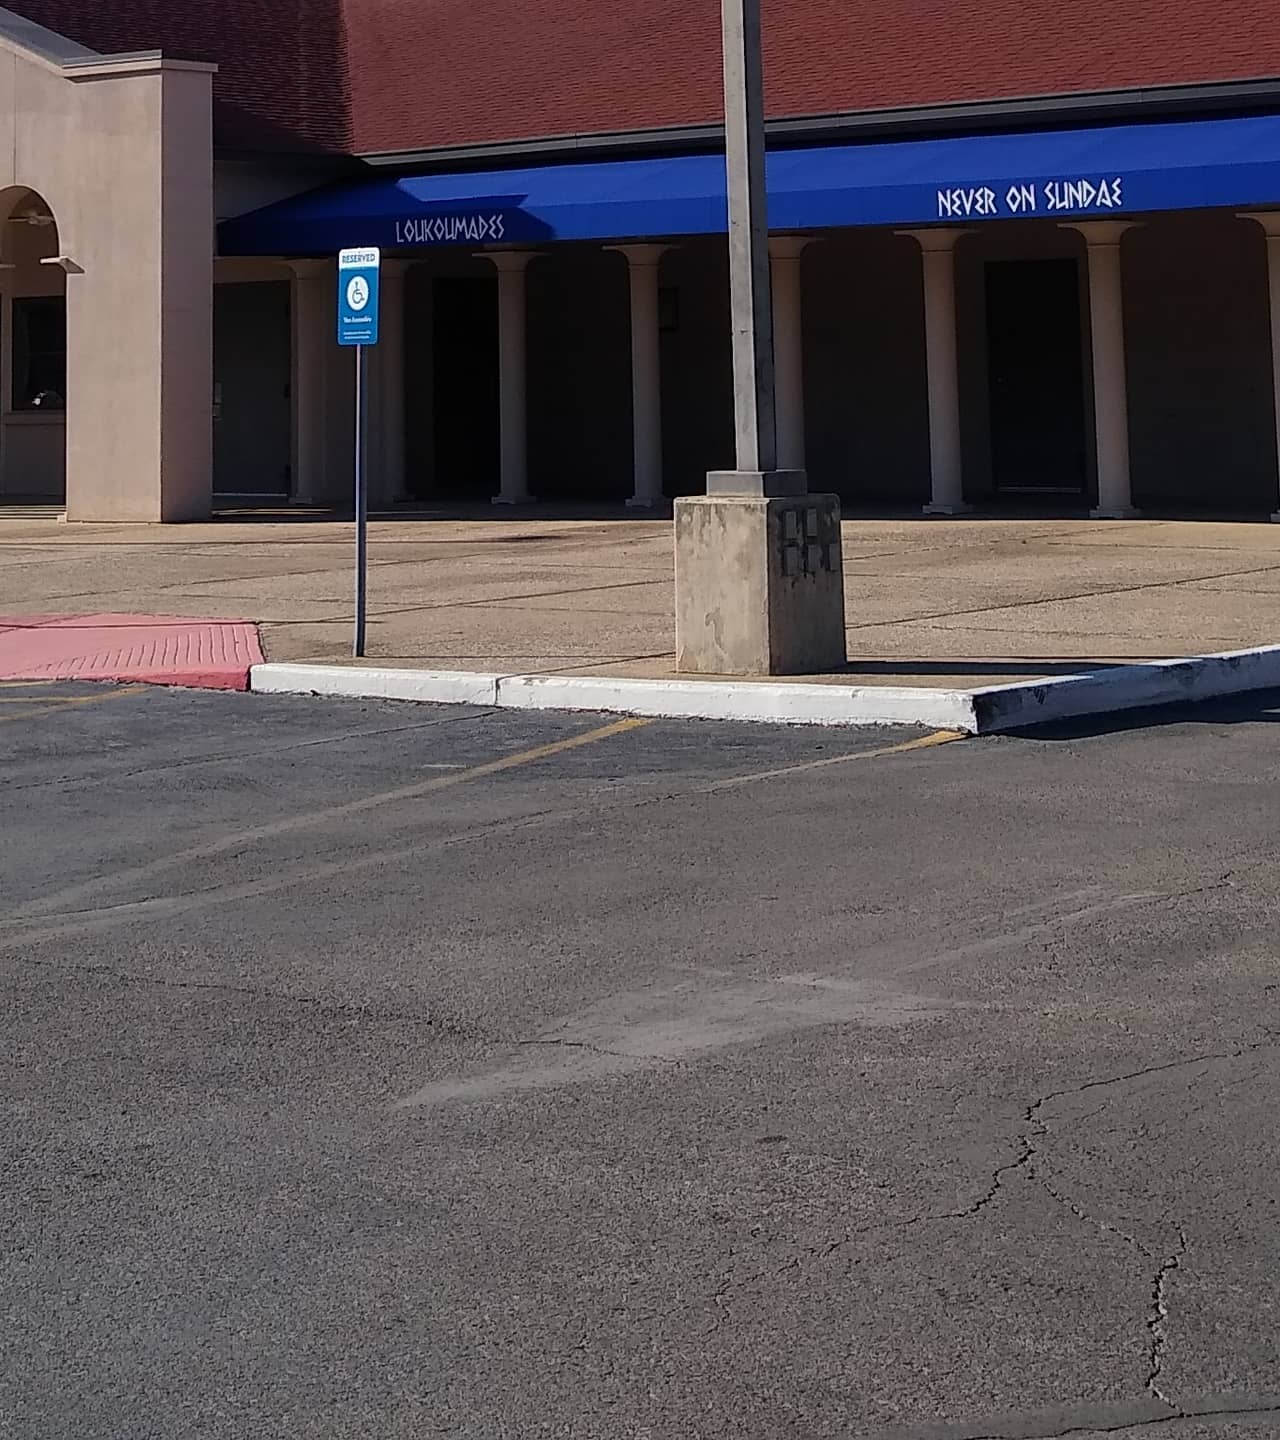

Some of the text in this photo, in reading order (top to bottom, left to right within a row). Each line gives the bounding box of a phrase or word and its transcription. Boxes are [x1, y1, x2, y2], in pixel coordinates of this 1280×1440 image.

[937, 177, 1122, 217] NEVER ON SUNDAE
[396, 214, 505, 243] LOUKOUMADES
[342, 253, 376, 264] RESERVED
